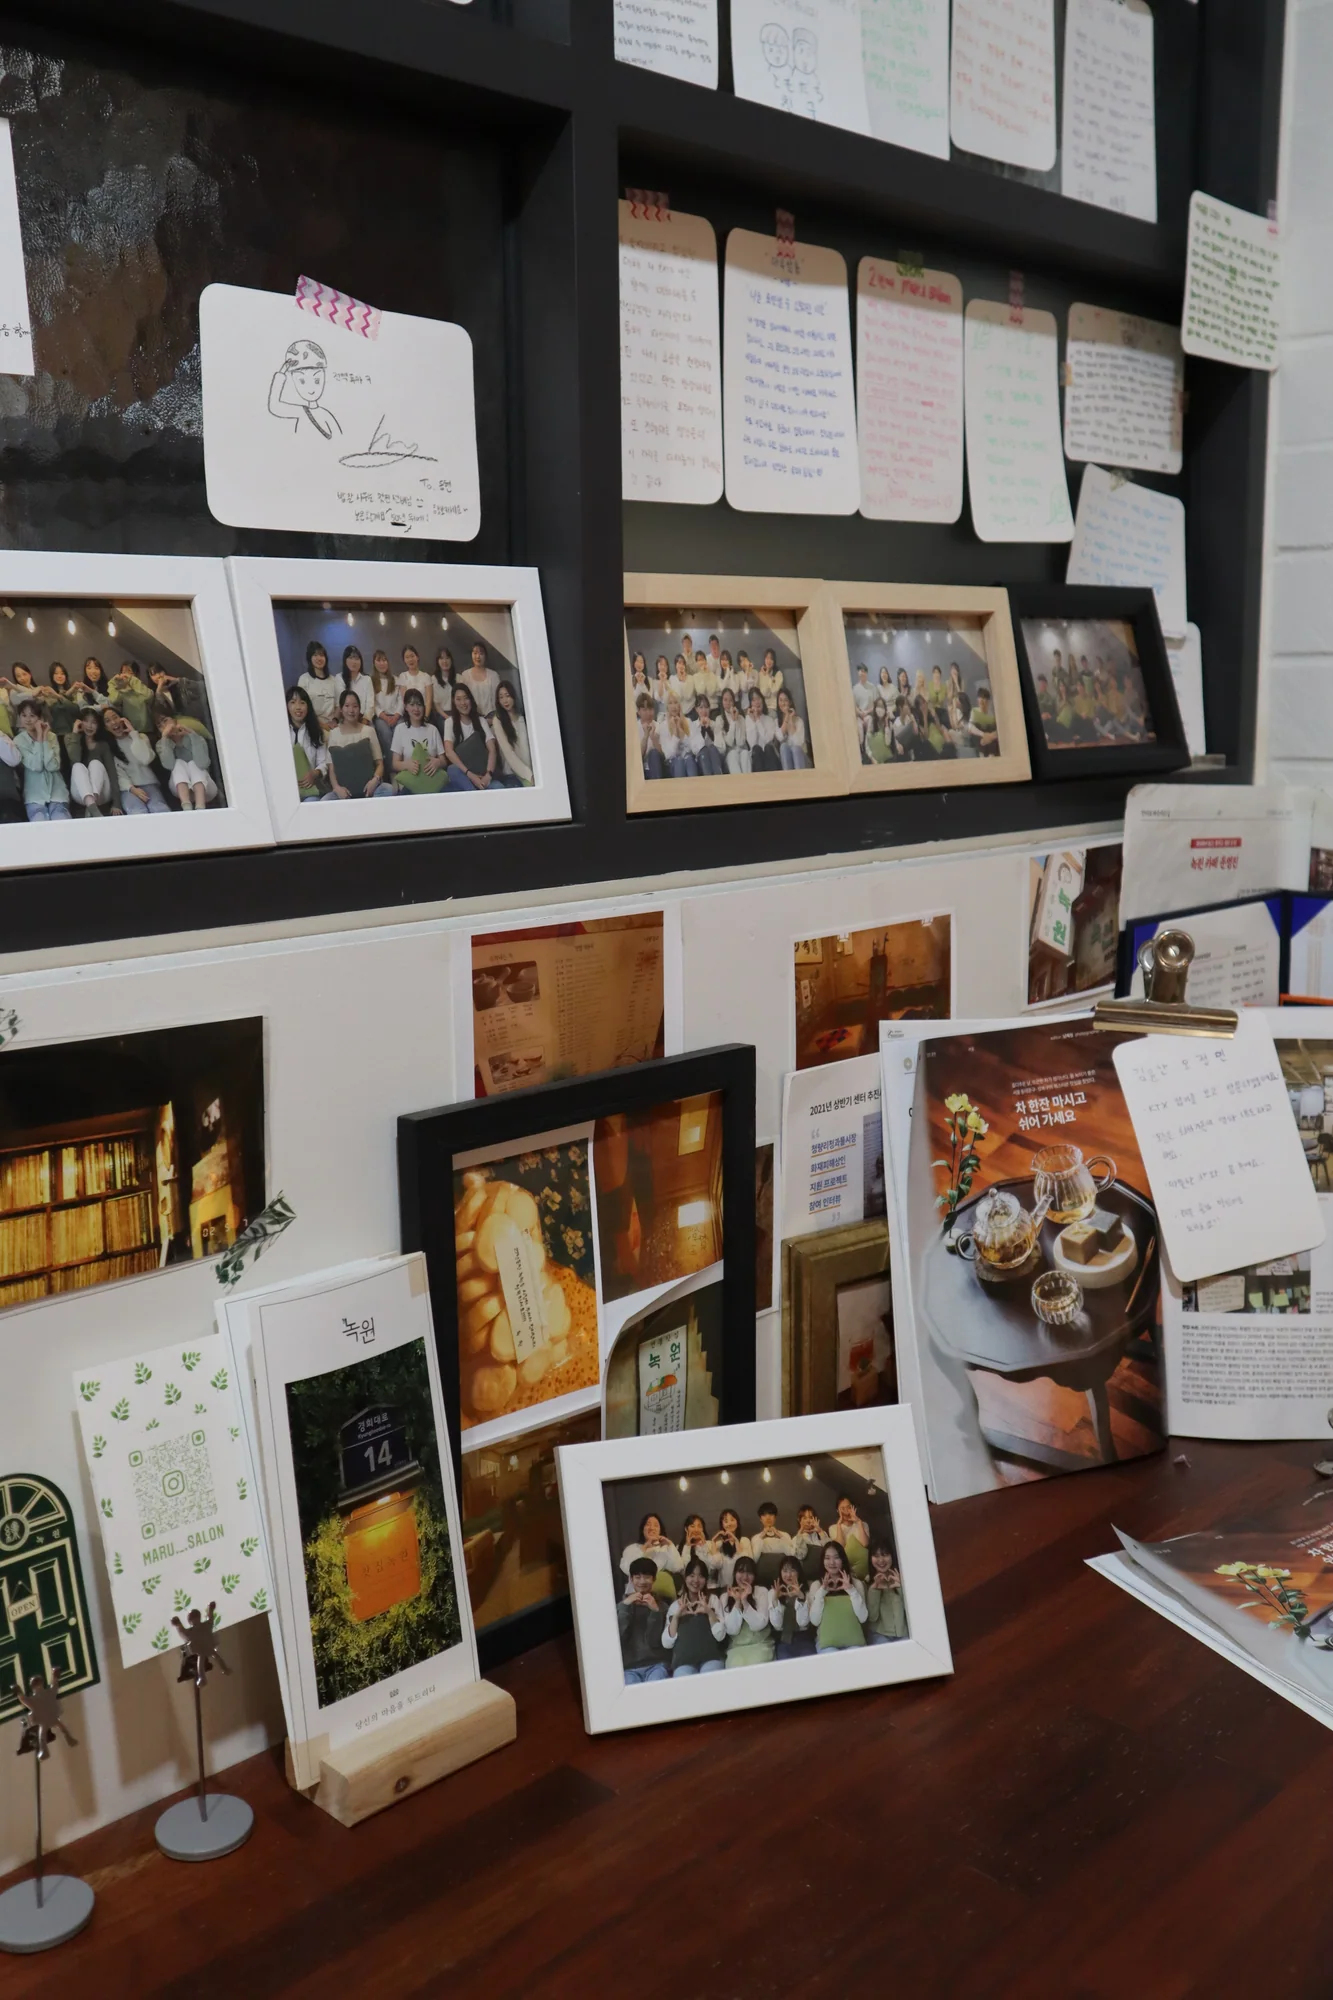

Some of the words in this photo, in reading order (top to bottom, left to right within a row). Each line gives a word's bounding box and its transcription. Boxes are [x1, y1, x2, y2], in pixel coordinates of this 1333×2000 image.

[810, 1100, 832, 1116] 2021년
[833, 1096, 852, 1110] 상반기
[853, 1092, 867, 1104] 센터
[867, 1088, 882, 1101] 추진
[1015, 1100, 1026, 1114] 차
[1028, 1097, 1050, 1113] 한잔
[1051, 1092, 1087, 1108] 마시고
[1019, 1115, 1041, 1131] 쉬어
[1042, 1110, 1077, 1127] 가세요
[810, 1181, 822, 1191] 지원
[342, 1317, 376, 1344] 녹원
[358, 1412, 389, 1433] 경희대로
[364, 1439, 393, 1473] 14
[11, 1600, 36, 1618] OPEN
[355, 1712, 378, 1730] 당신의
[381, 1701, 403, 1716] 마음을
[407, 1684, 436, 1704] 두드리다
